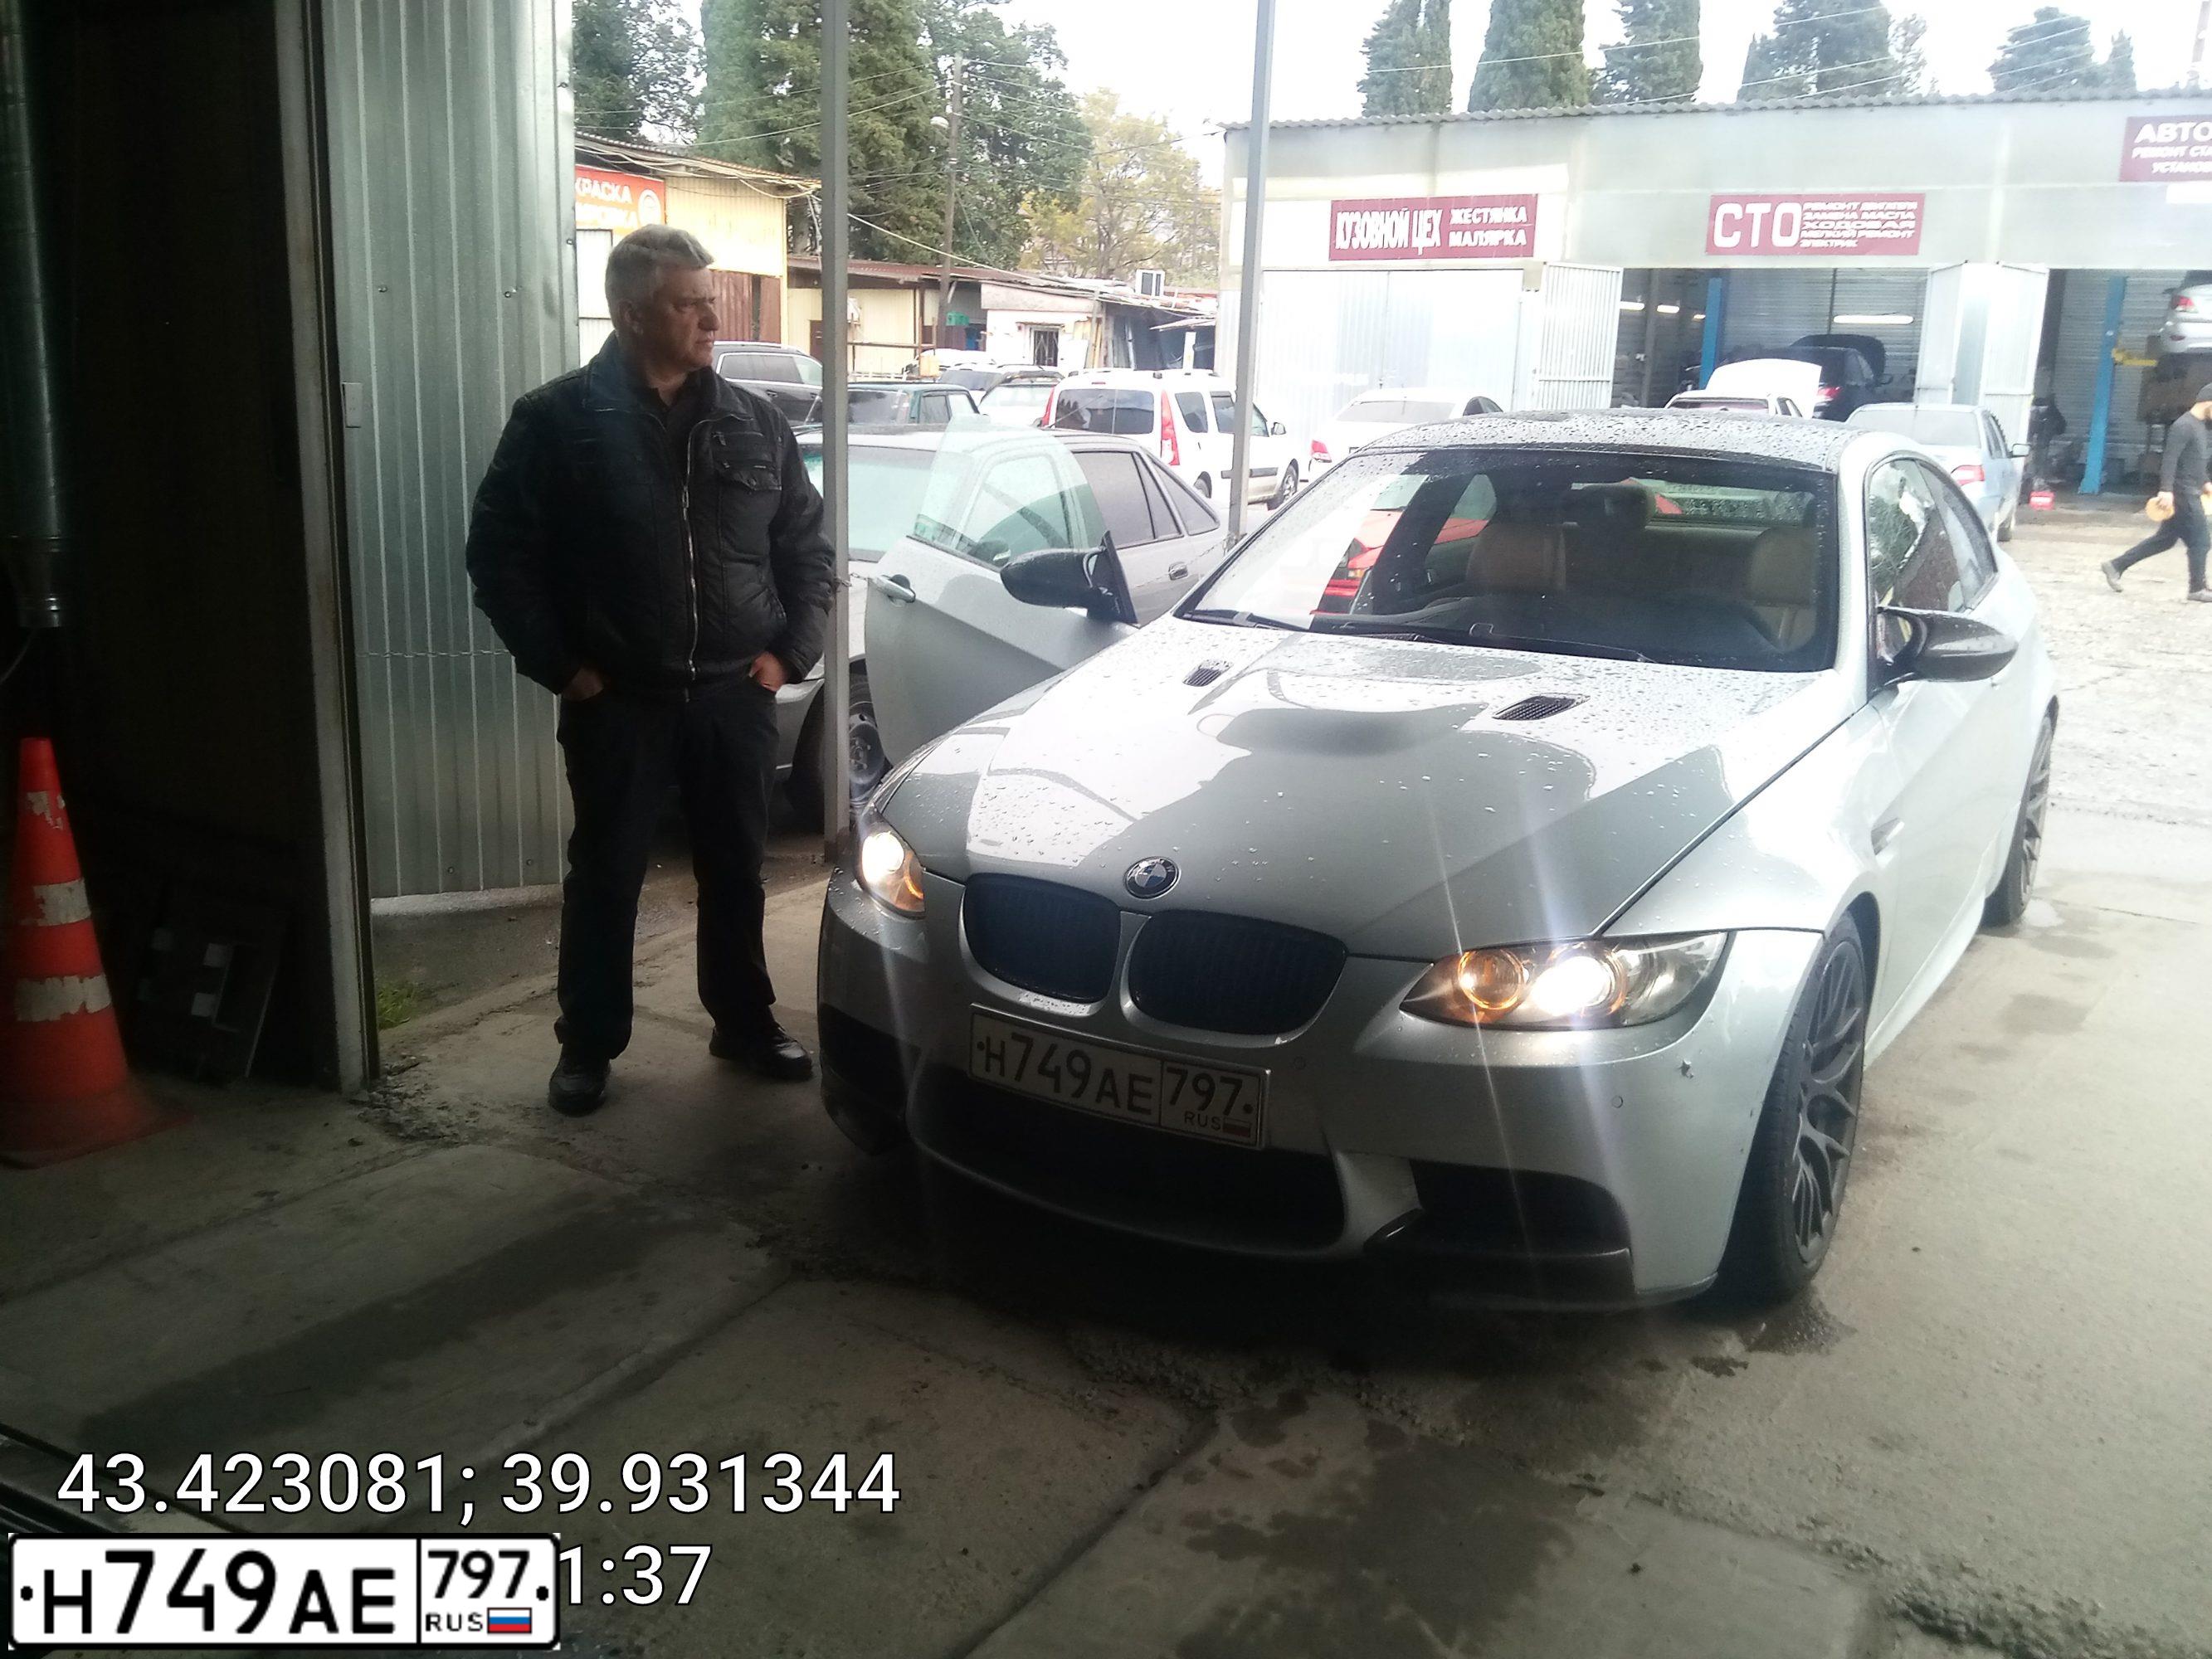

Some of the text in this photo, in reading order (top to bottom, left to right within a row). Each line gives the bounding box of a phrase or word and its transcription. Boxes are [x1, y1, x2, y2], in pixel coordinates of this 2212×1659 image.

[1449, 207, 1527, 225] ЖЕСТЯНКА
[1713, 202, 1802, 248] СТО
[1801, 221, 1916, 229] ХОДОВАЯ
[1335, 208, 1443, 255] КУЗОВНОЙ ЦЕХ
[1449, 230, 1527, 247] МАЛЯРКА
[1167, 1067, 1245, 1117] 797
[1184, 1111, 1221, 1131] RUS
